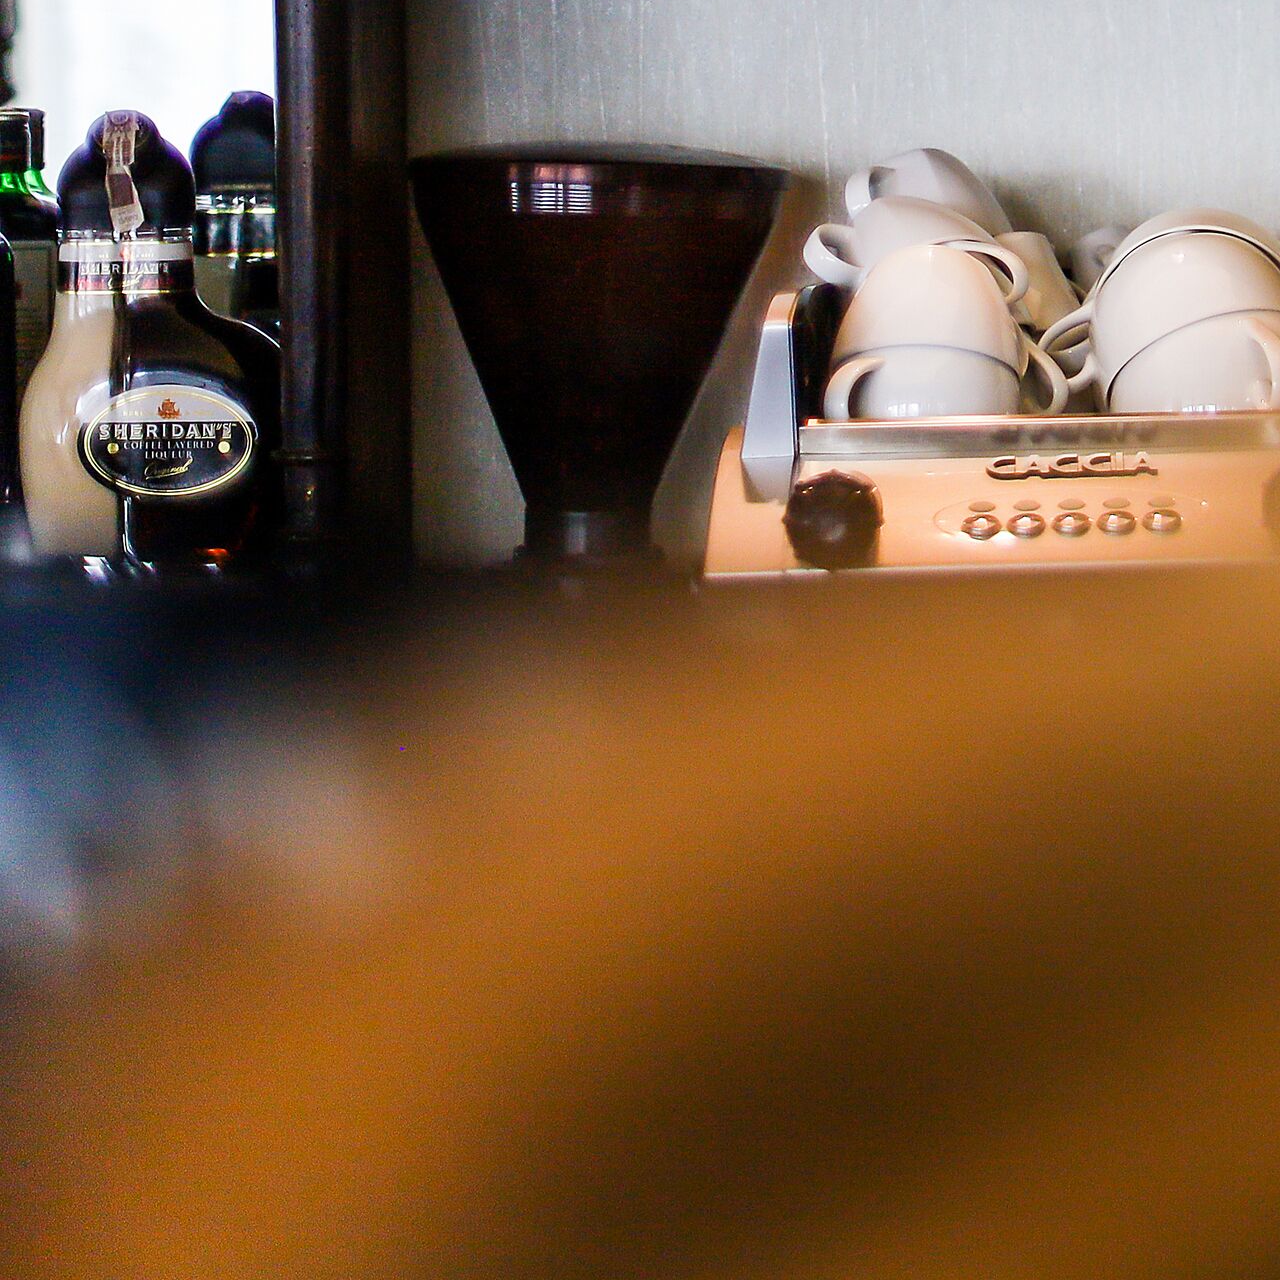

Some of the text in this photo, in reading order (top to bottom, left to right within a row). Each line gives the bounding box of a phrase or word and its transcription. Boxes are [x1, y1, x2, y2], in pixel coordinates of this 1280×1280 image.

[99, 423, 232, 441] SHERIDAN'S
[123, 440, 214, 450] COFFEE LAYERED
[145, 450, 193, 459] LIQUEUR
